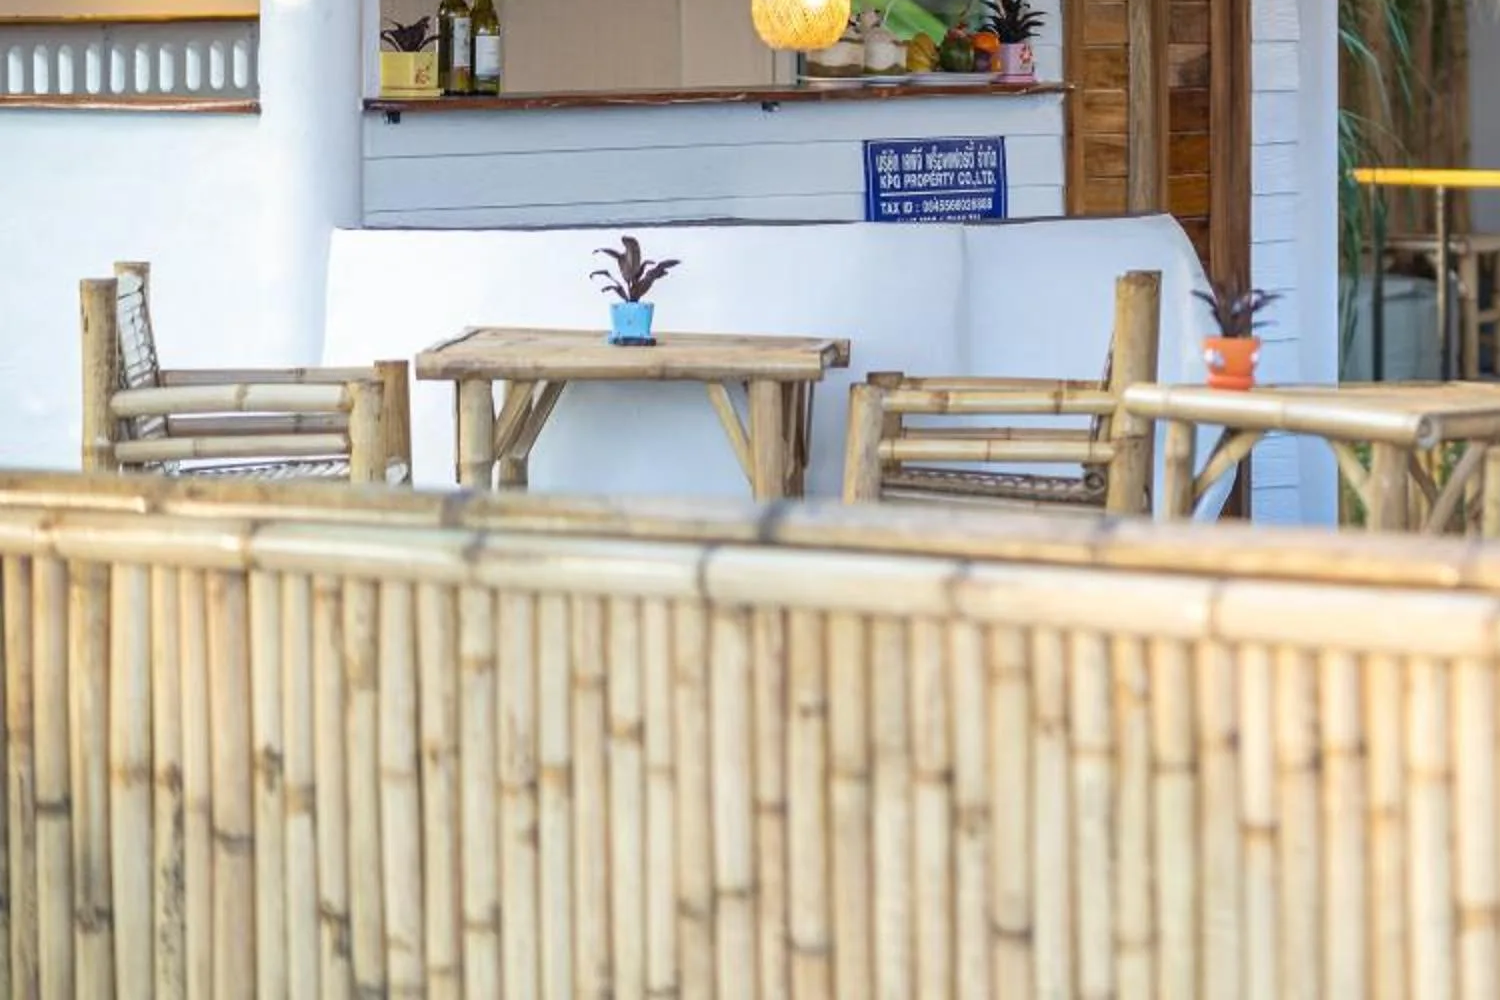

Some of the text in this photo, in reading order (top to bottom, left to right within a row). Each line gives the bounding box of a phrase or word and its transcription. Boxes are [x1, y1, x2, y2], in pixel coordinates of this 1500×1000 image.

[903, 172, 954, 188] PROPERTY
[880, 201, 900, 215] TAX
[903, 201, 913, 213] ID
